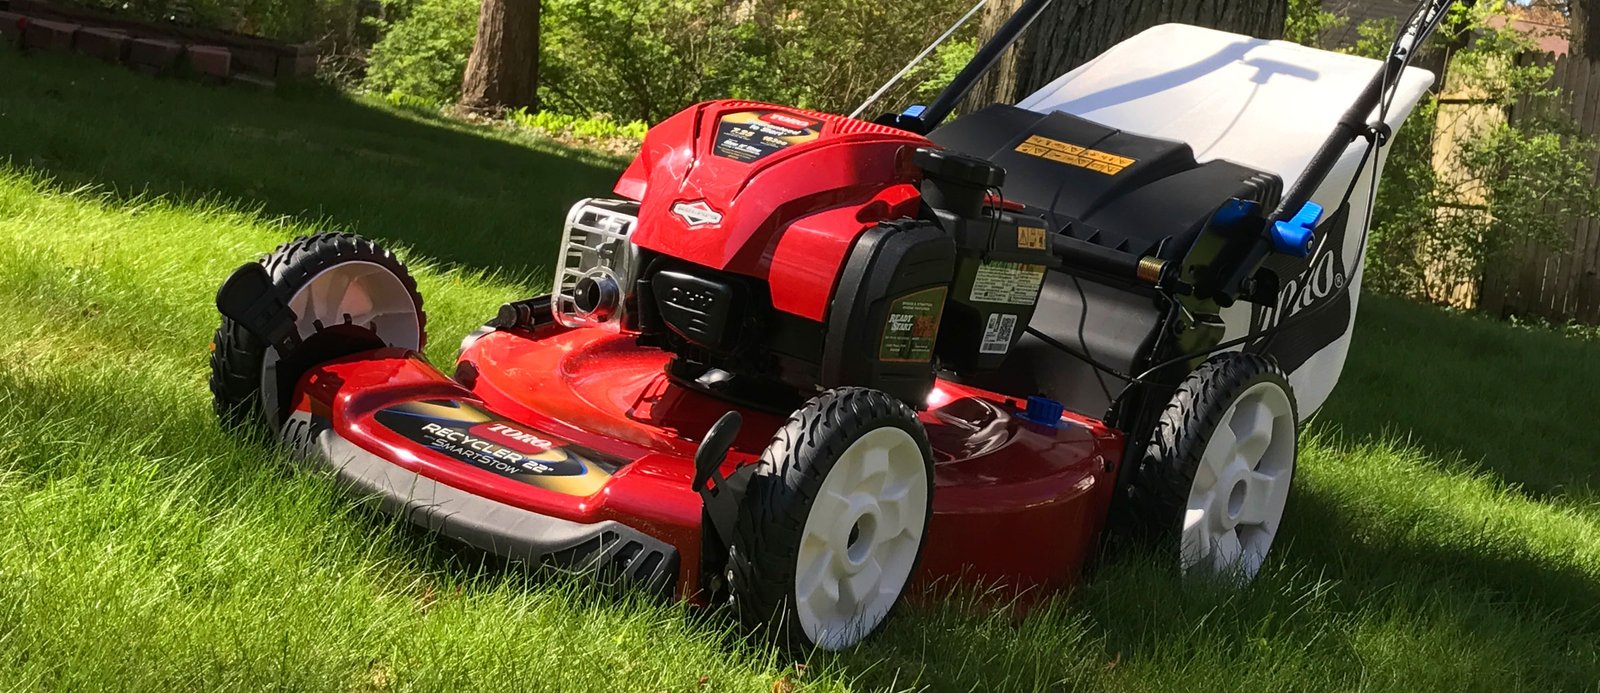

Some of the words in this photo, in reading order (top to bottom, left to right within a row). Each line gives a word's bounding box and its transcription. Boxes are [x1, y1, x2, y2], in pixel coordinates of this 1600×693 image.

[888, 313, 914, 323] READY
[890, 322, 914, 333] START
[421, 422, 523, 464] RECYCLER
[487, 423, 553, 450] TORO
